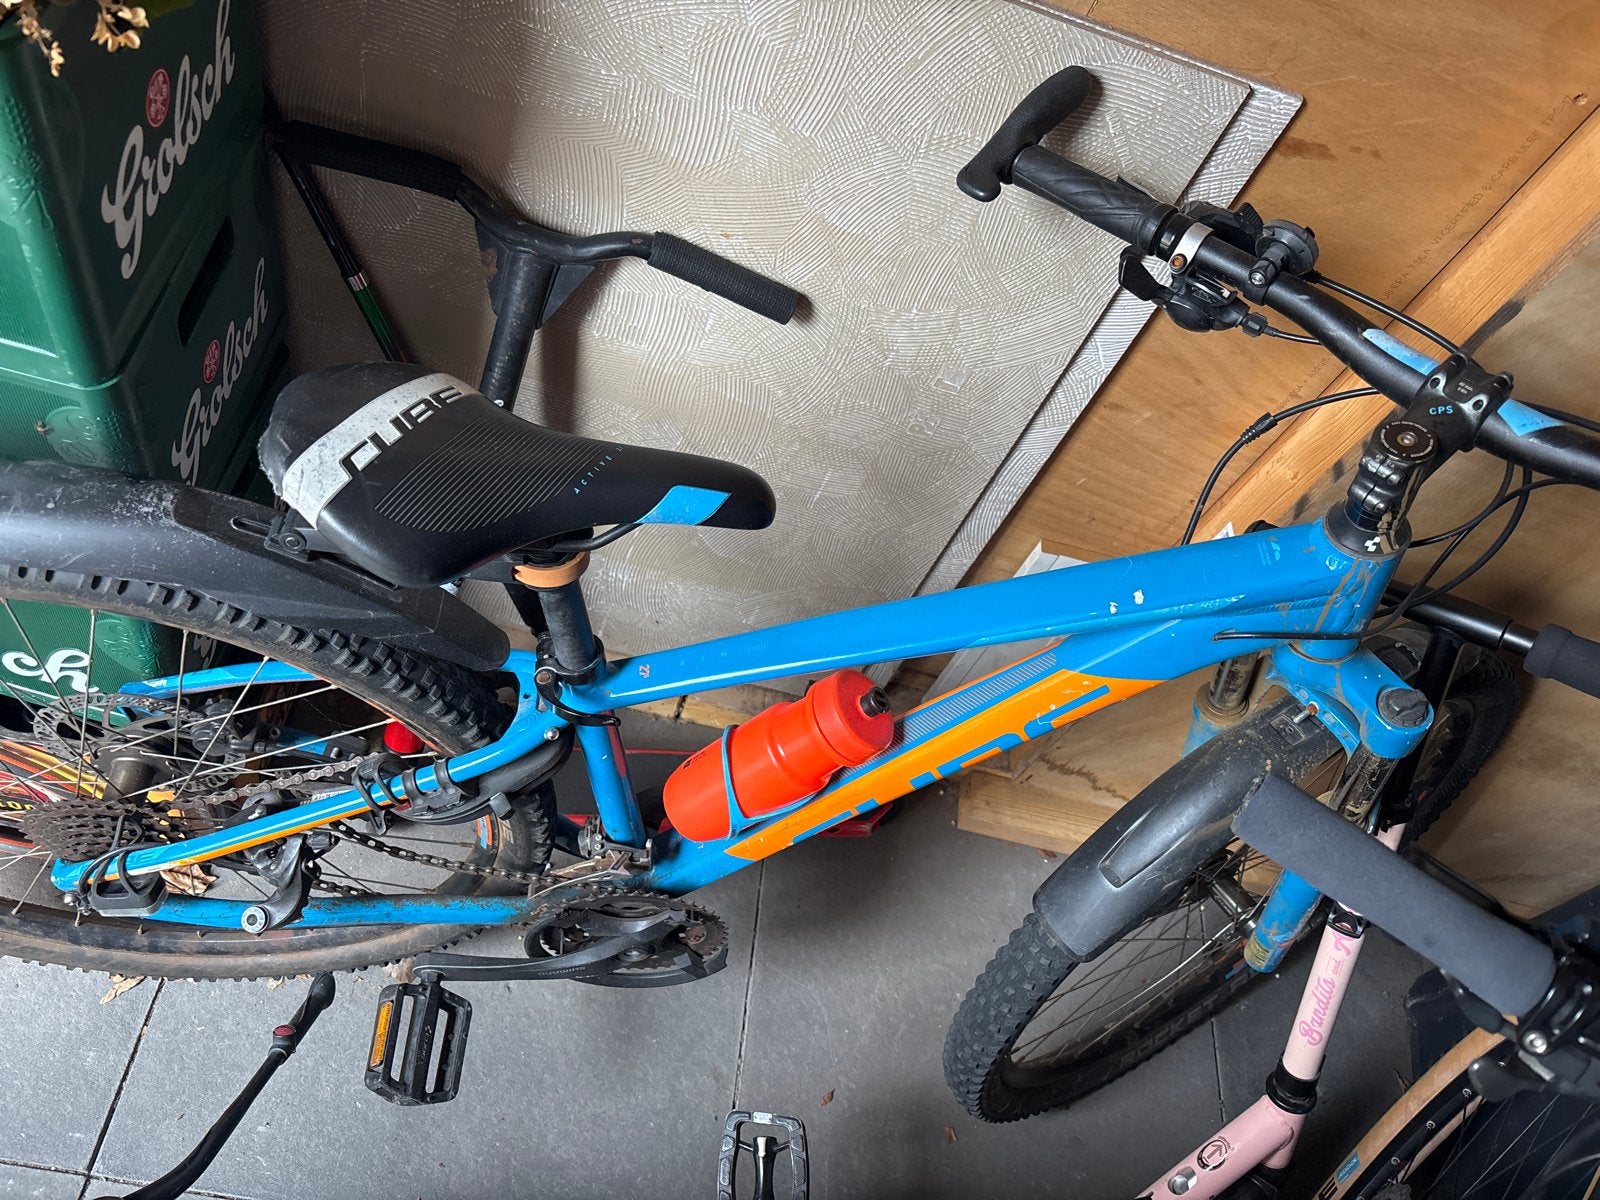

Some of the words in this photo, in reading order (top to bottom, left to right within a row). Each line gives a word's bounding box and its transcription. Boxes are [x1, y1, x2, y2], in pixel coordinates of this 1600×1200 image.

[101, 0, 235, 279] Grolsch
[172, 257, 268, 486] Grolsch
[1429, 405, 1454, 415] CPS
[339, 385, 465, 481] CUBE
[573, 455, 612, 494] ACTIVE
[1299, 975, 1336, 1046] Bandits
